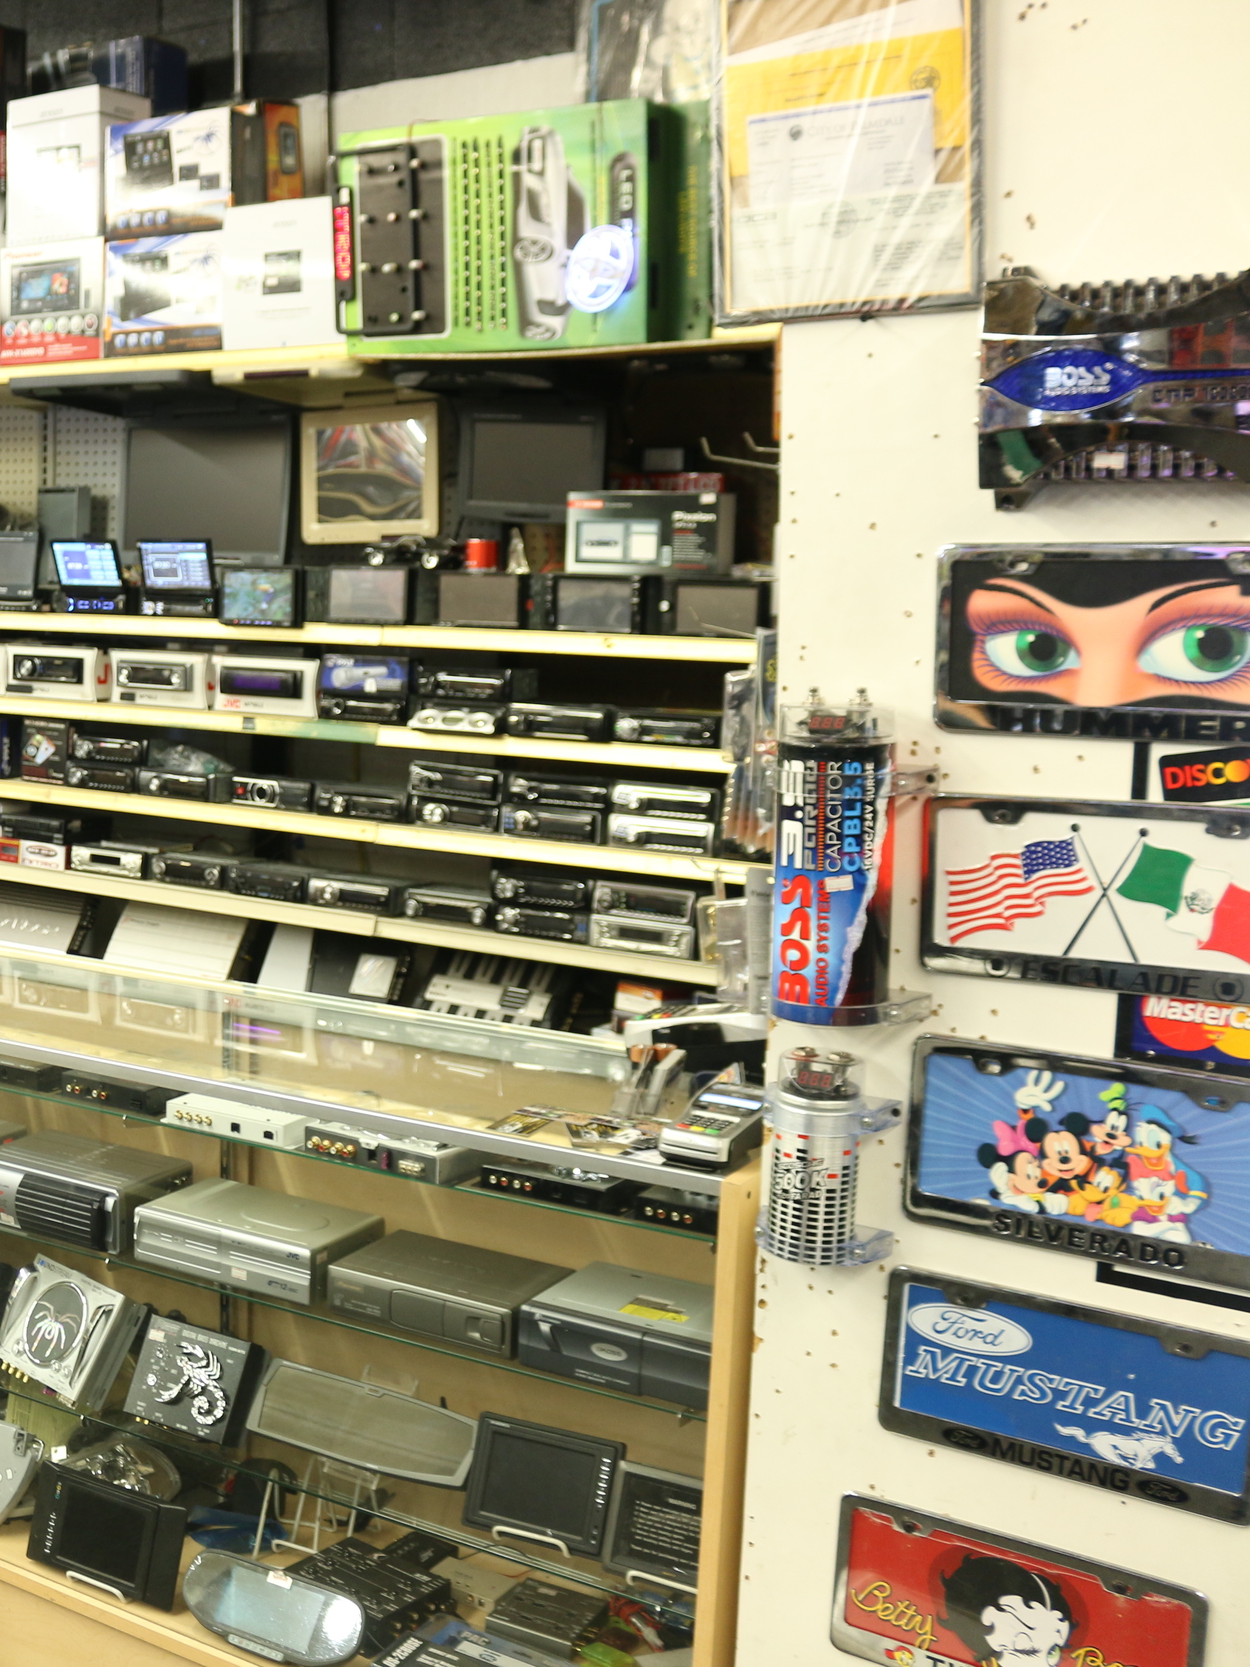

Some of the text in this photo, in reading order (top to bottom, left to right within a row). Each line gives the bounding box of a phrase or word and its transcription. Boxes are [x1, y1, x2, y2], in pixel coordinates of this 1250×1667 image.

[618, 168, 634, 211] LED
[1044, 364, 1112, 388] BOSS
[223, 699, 241, 708] JVC
[1163, 759, 1250, 790] DISCO
[825, 761, 842, 873] CAPACITOR
[842, 761, 863, 872] CPBL3.5
[777, 874, 812, 1006] BOSS
[814, 879, 831, 1007] AUDIO SYSTEMS
[1021, 958, 1202, 998] ESCALADE
[1143, 996, 1250, 1031] MasterCa
[286, 1251, 300, 1261] JVC
[992, 1212, 1189, 1270] SILVERADO
[932, 1309, 1006, 1348] Ford
[906, 1345, 1246, 1452] MUSTANG
[988, 1436, 1131, 1492] MUSTANG
[851, 1581, 938, 1650] Betty
[460, 1631, 490, 1645] PAC
